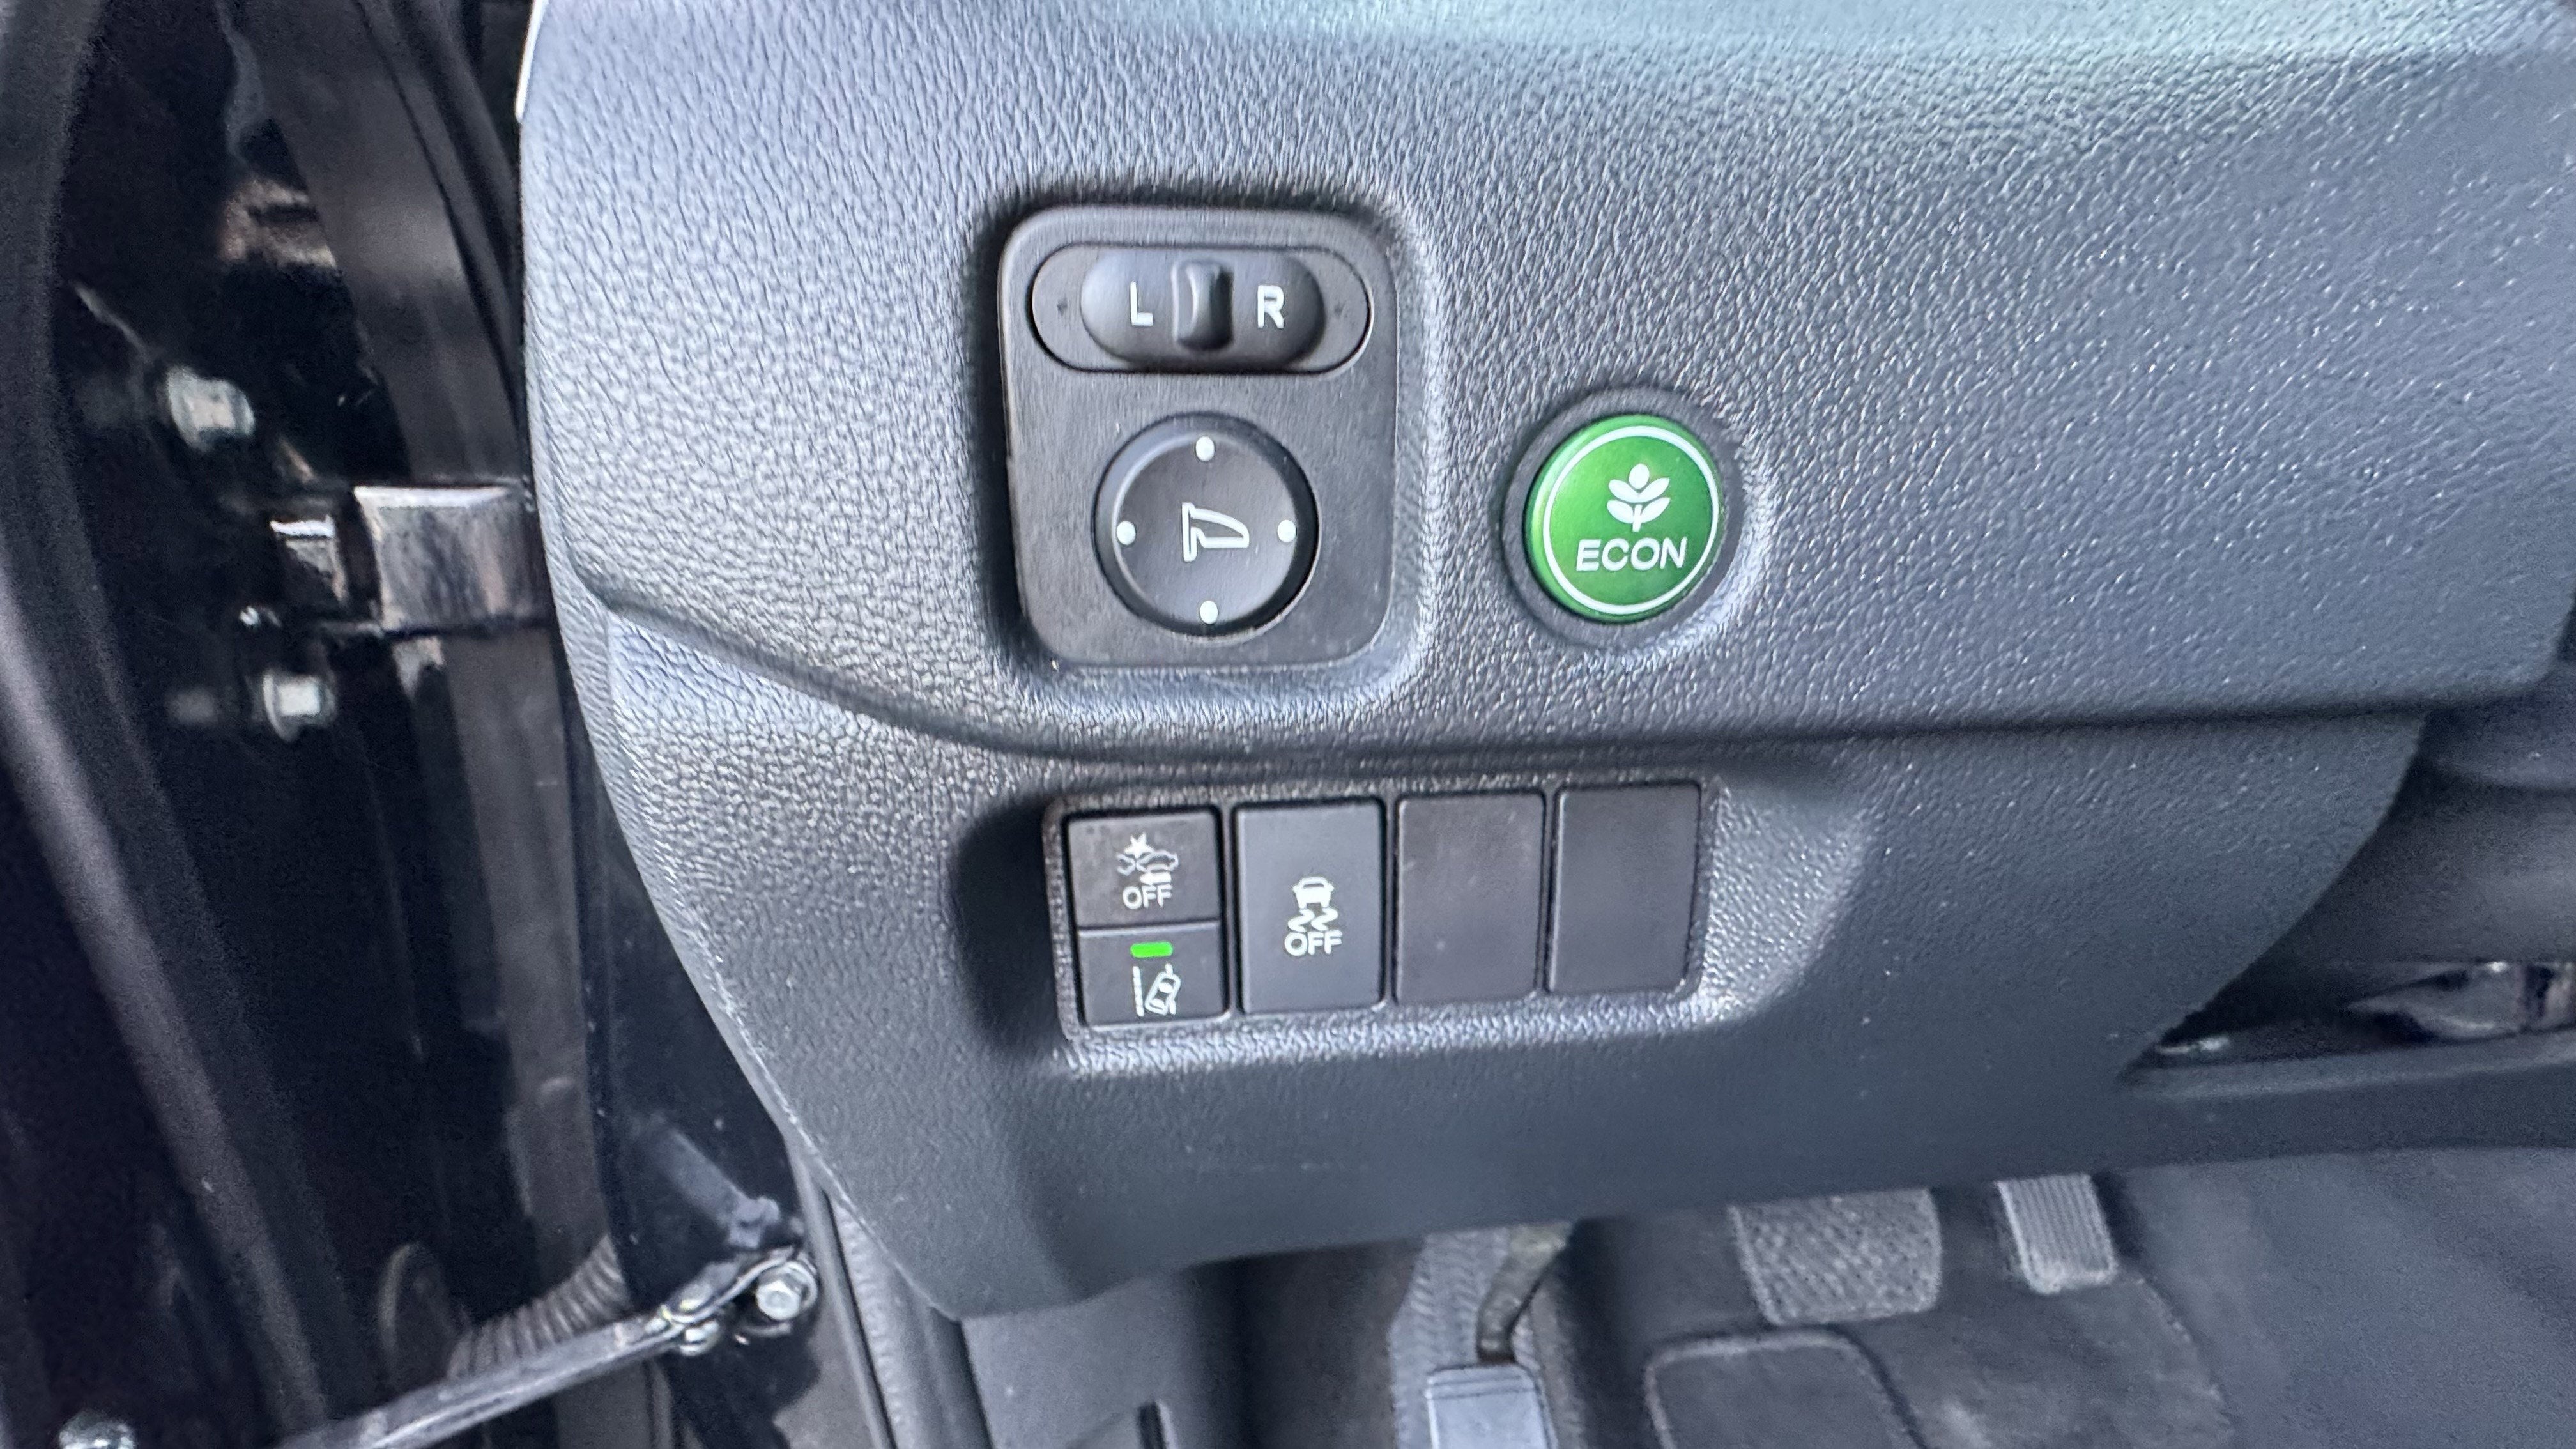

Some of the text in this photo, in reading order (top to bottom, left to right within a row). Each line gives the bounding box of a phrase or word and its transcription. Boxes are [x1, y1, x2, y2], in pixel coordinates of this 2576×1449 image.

[1130, 281, 1284, 328] L R
[1576, 537, 1688, 571] ECON
[1122, 884, 1173, 909] OFF
[1284, 930, 1342, 956] OFF
